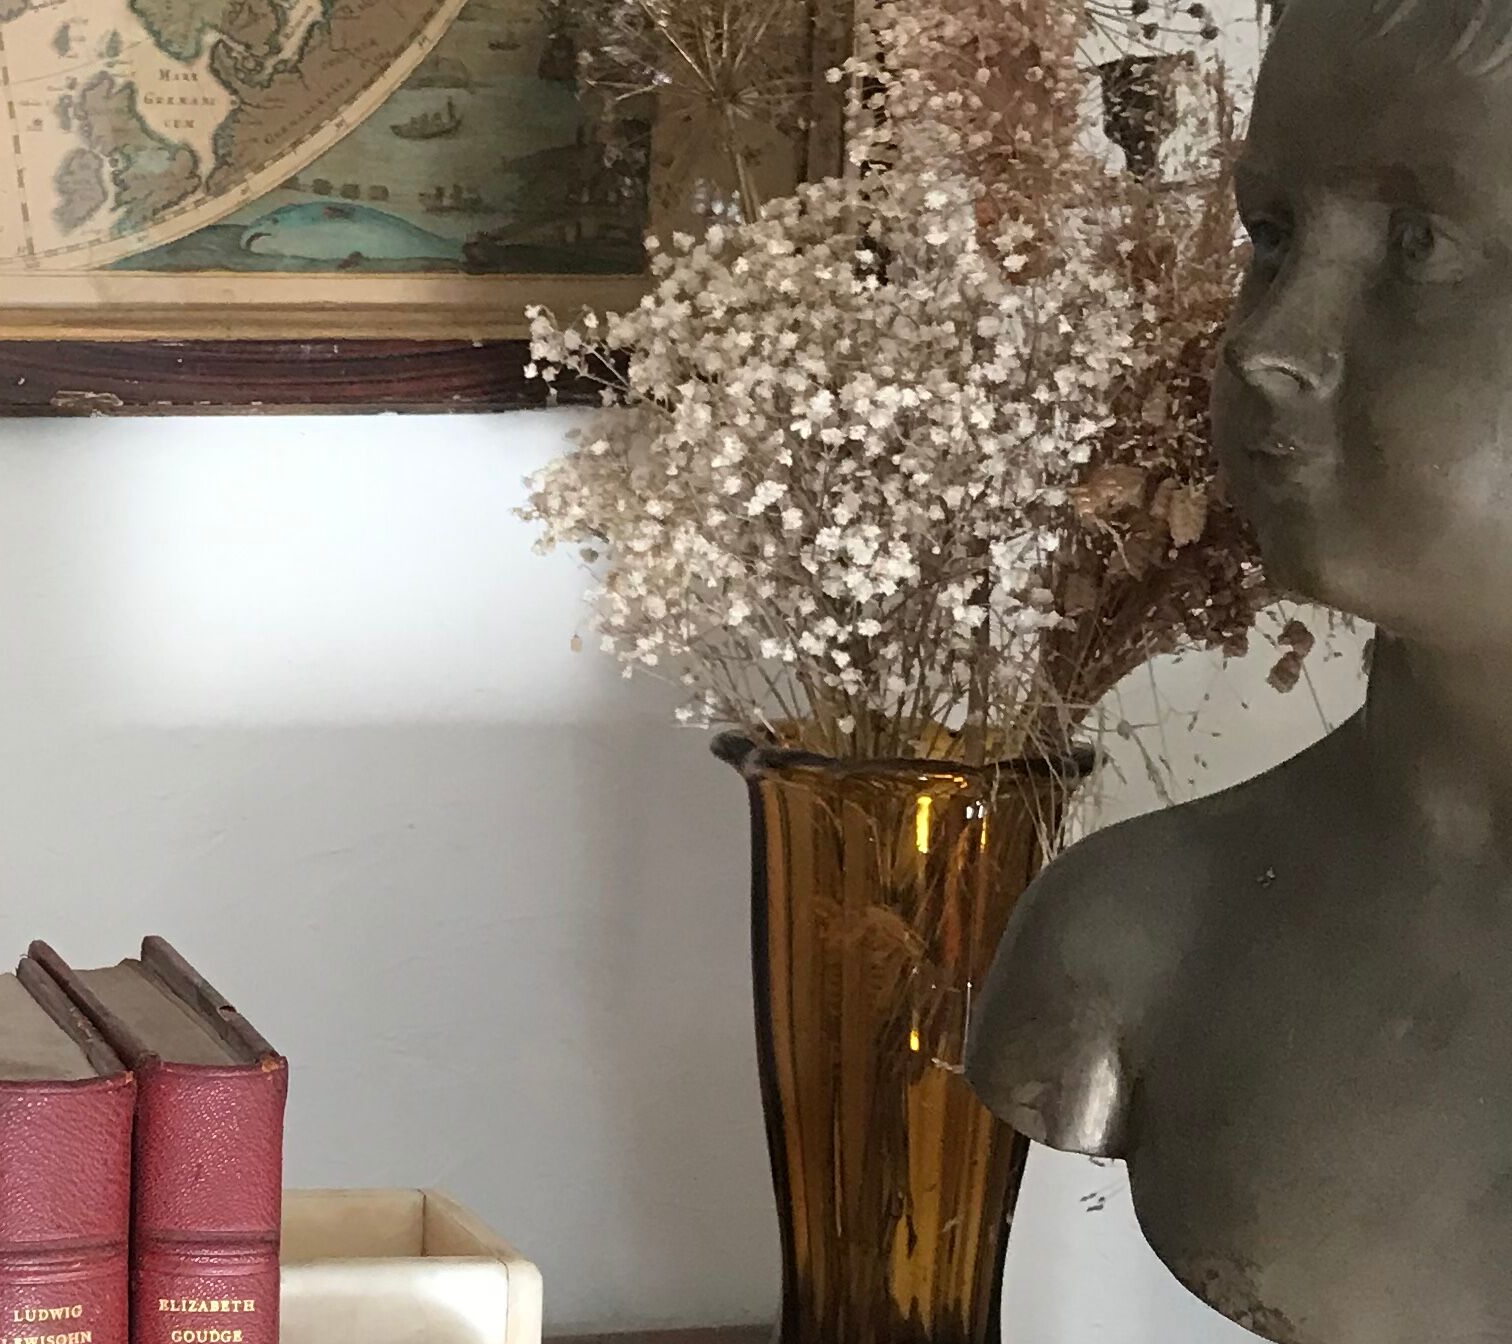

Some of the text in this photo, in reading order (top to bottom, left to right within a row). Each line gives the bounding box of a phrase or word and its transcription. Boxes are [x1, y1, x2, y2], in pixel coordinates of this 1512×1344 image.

[13, 1304, 84, 1323] LUDWIG
[158, 1298, 256, 1314] ELIZABETH
[171, 1329, 244, 1344] GOUDGE
